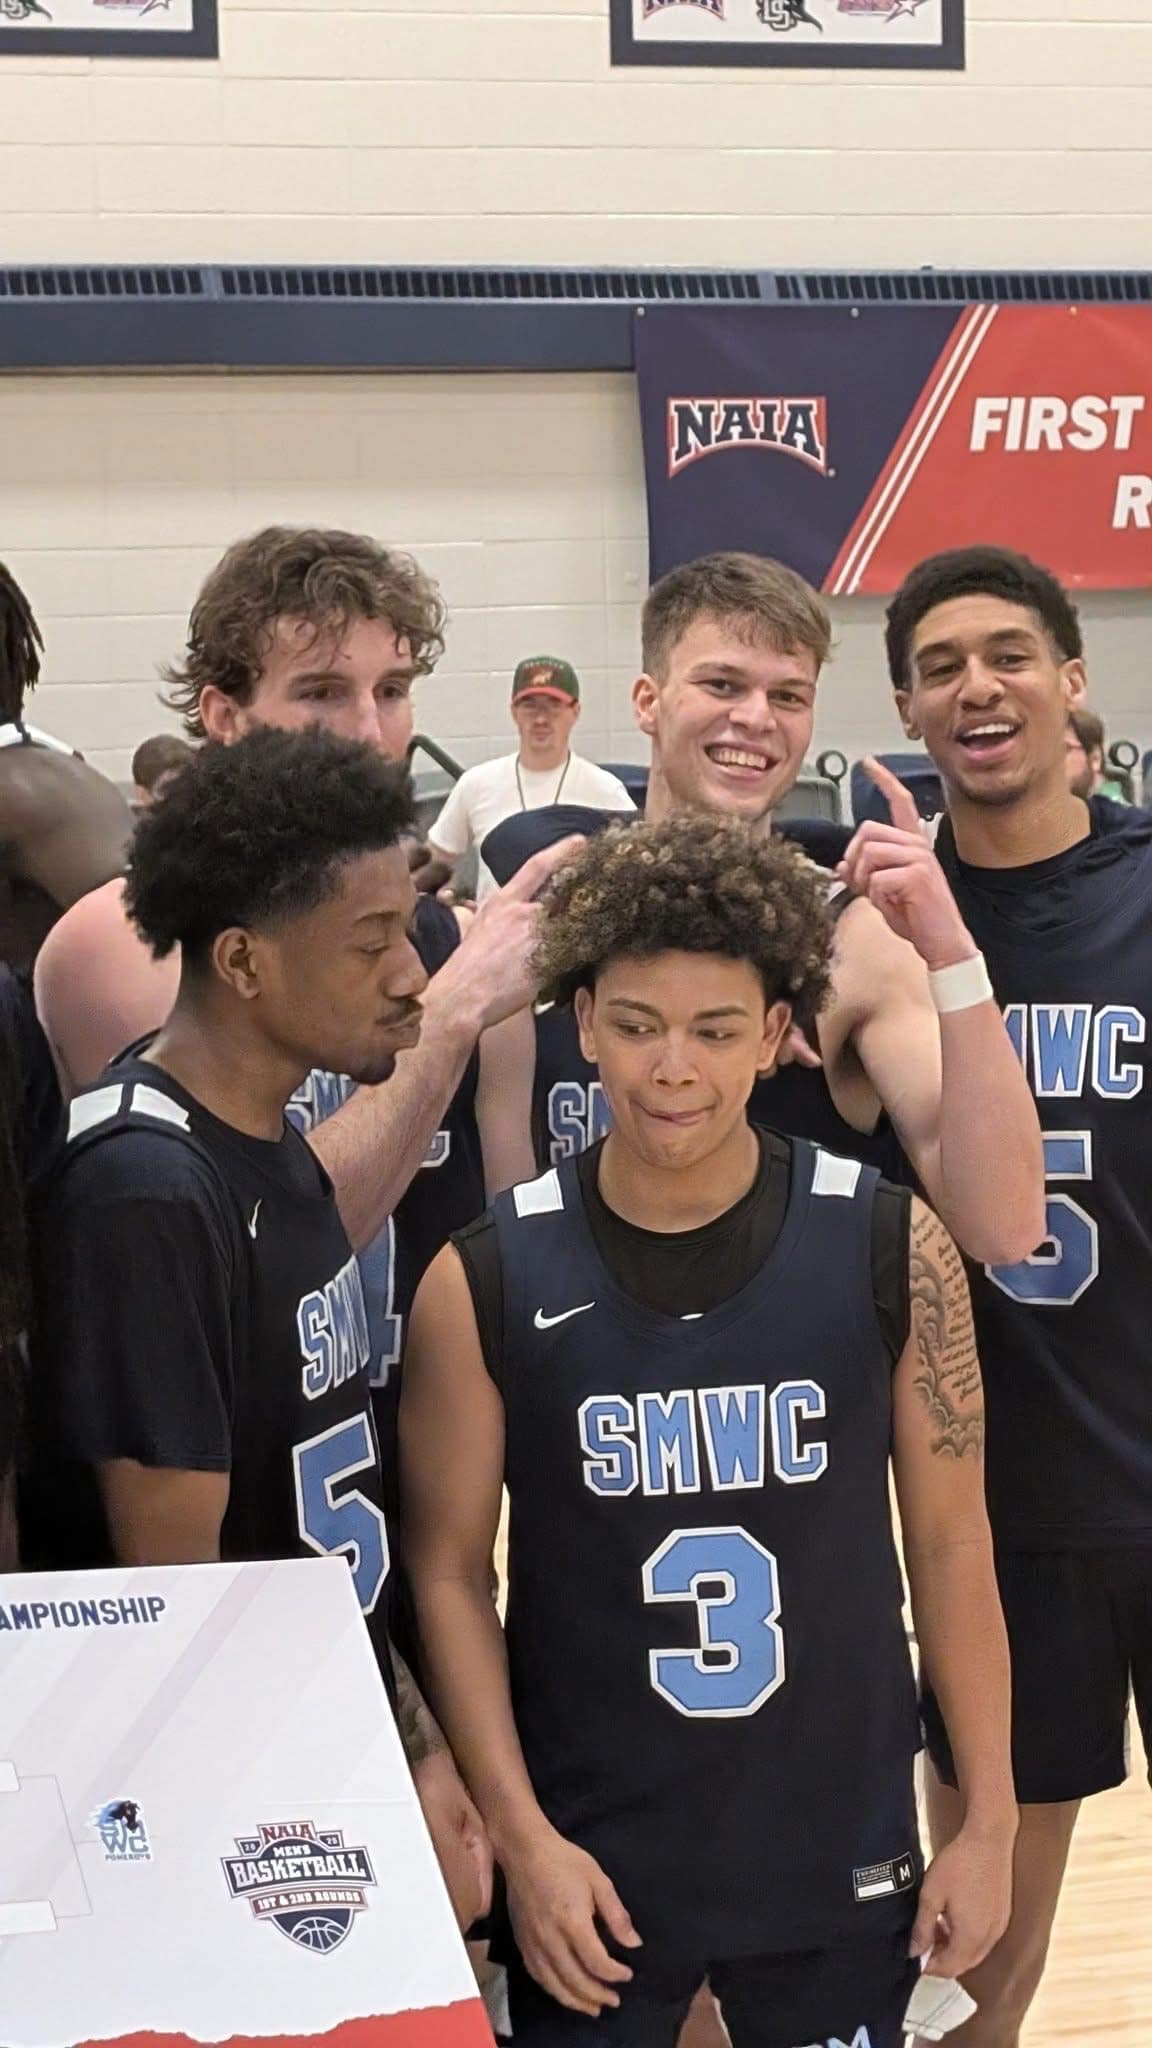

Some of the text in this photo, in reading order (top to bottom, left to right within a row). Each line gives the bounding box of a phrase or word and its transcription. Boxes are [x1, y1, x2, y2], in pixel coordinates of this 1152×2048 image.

[671, 399, 827, 467] NAIA
[969, 395, 1145, 452] FIRST
[577, 1379, 829, 1497] SMWC
[0, 1596, 166, 1631] AMPIONSHIP
[641, 1525, 786, 1718] 3
[261, 1823, 315, 1845] NAIA
[230, 1853, 367, 1889] BASKETBALL
[899, 1863, 911, 1881] M
